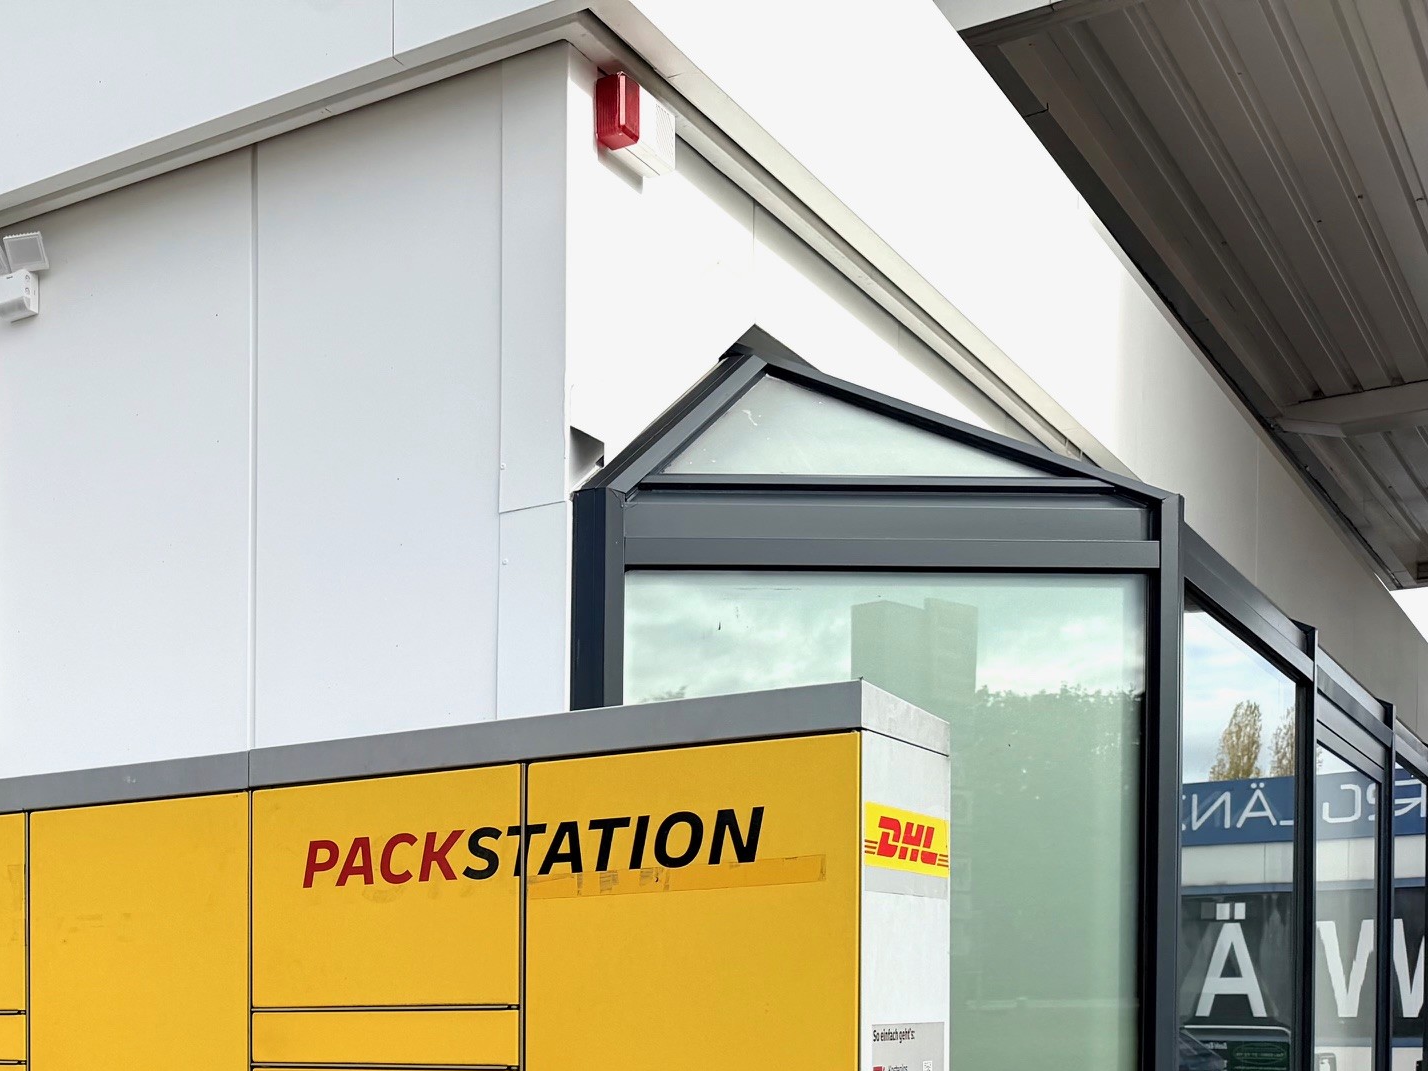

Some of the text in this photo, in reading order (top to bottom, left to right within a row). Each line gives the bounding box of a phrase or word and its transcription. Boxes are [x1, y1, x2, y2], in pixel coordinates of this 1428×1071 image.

[302, 806, 765, 889] PACKSTATION
[876, 815, 939, 866] DHL
[873, 1028, 915, 1044] So einfach geht's:
